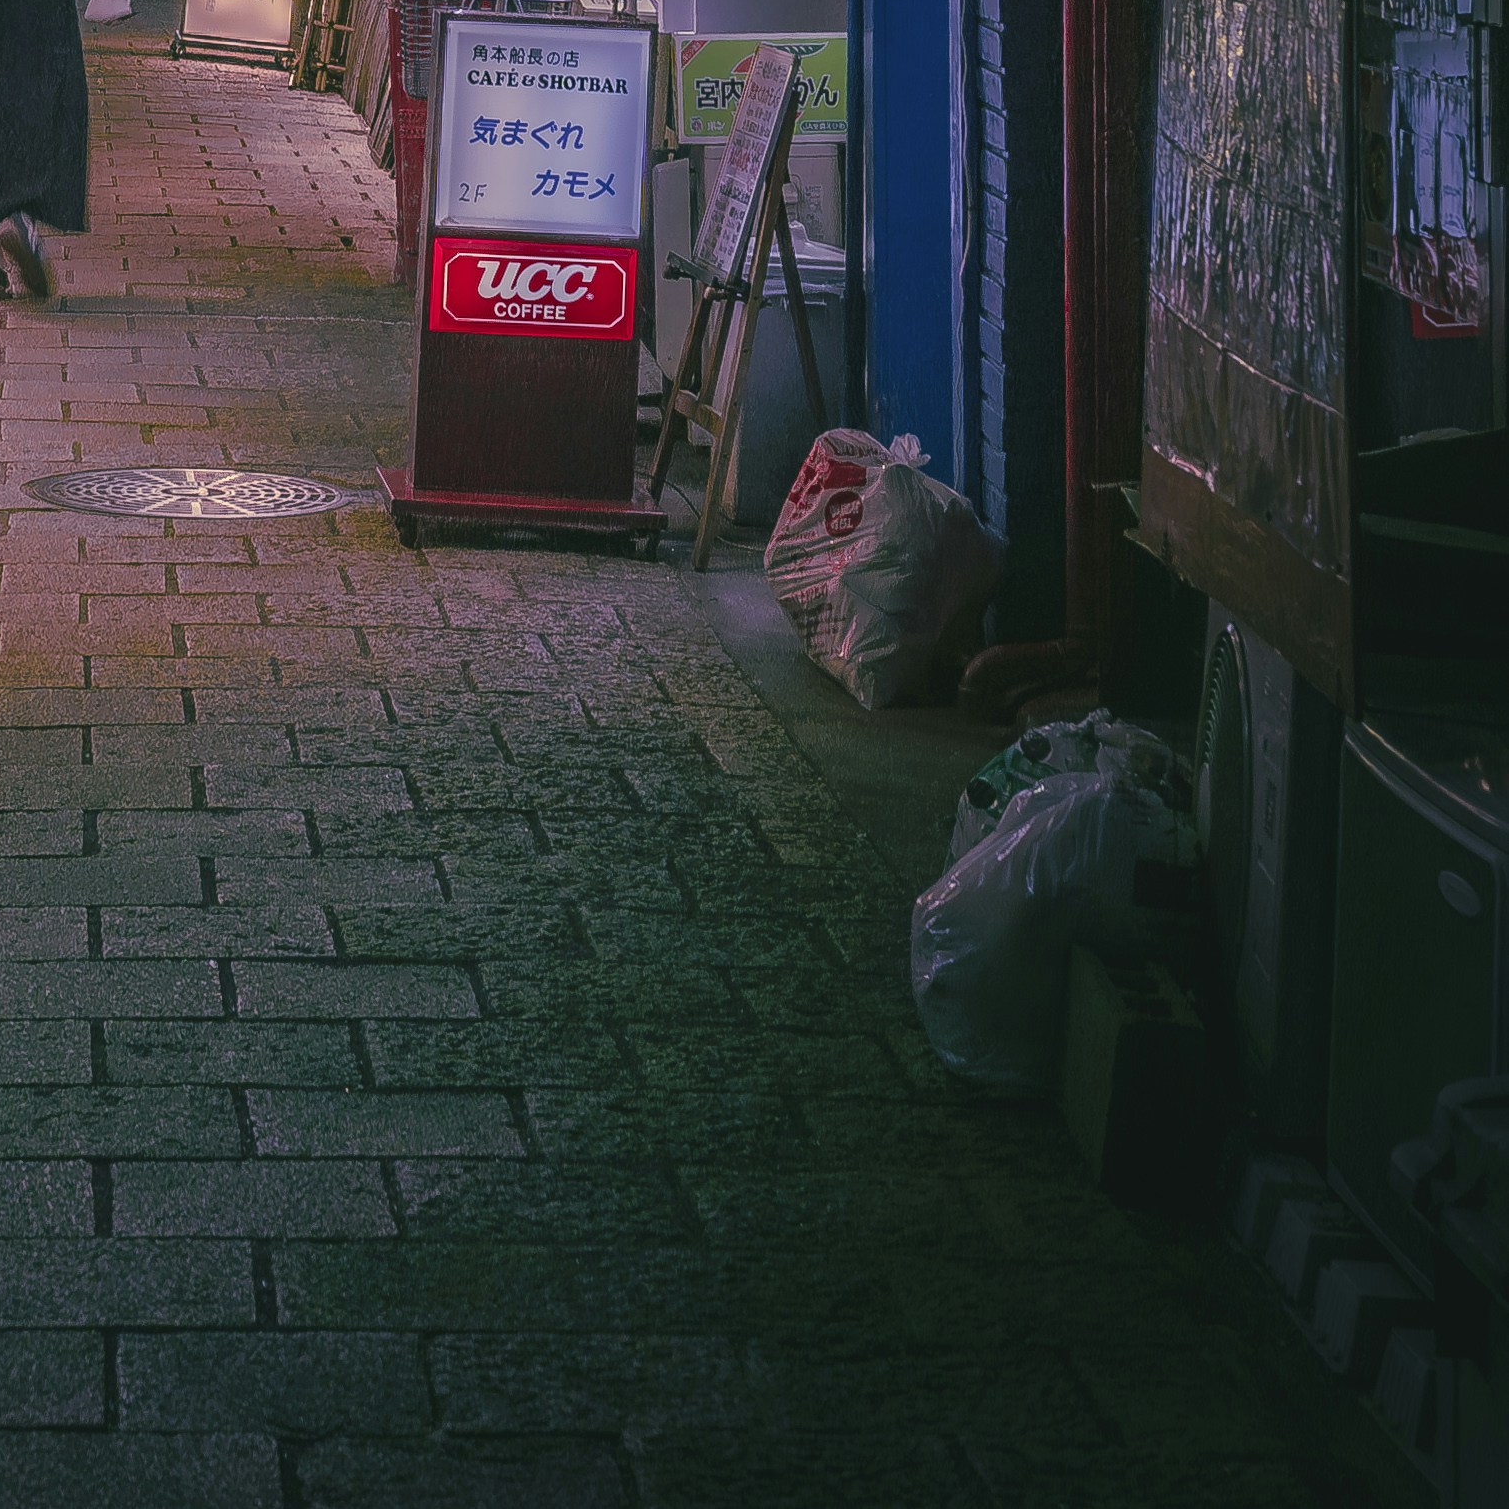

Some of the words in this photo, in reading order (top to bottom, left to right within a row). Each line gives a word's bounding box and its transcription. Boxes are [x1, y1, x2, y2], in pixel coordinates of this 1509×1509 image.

[471, 44, 580, 68] 角本船長の店
[467, 67, 519, 87] CAFÉ
[538, 72, 629, 96] SHOTBAR
[695, 74, 839, 110] 宮内かん
[468, 116, 585, 150] 気まぐれ
[458, 182, 487, 205] 2F
[530, 169, 618, 200] カモメ
[493, 303, 567, 321] COFFEE
